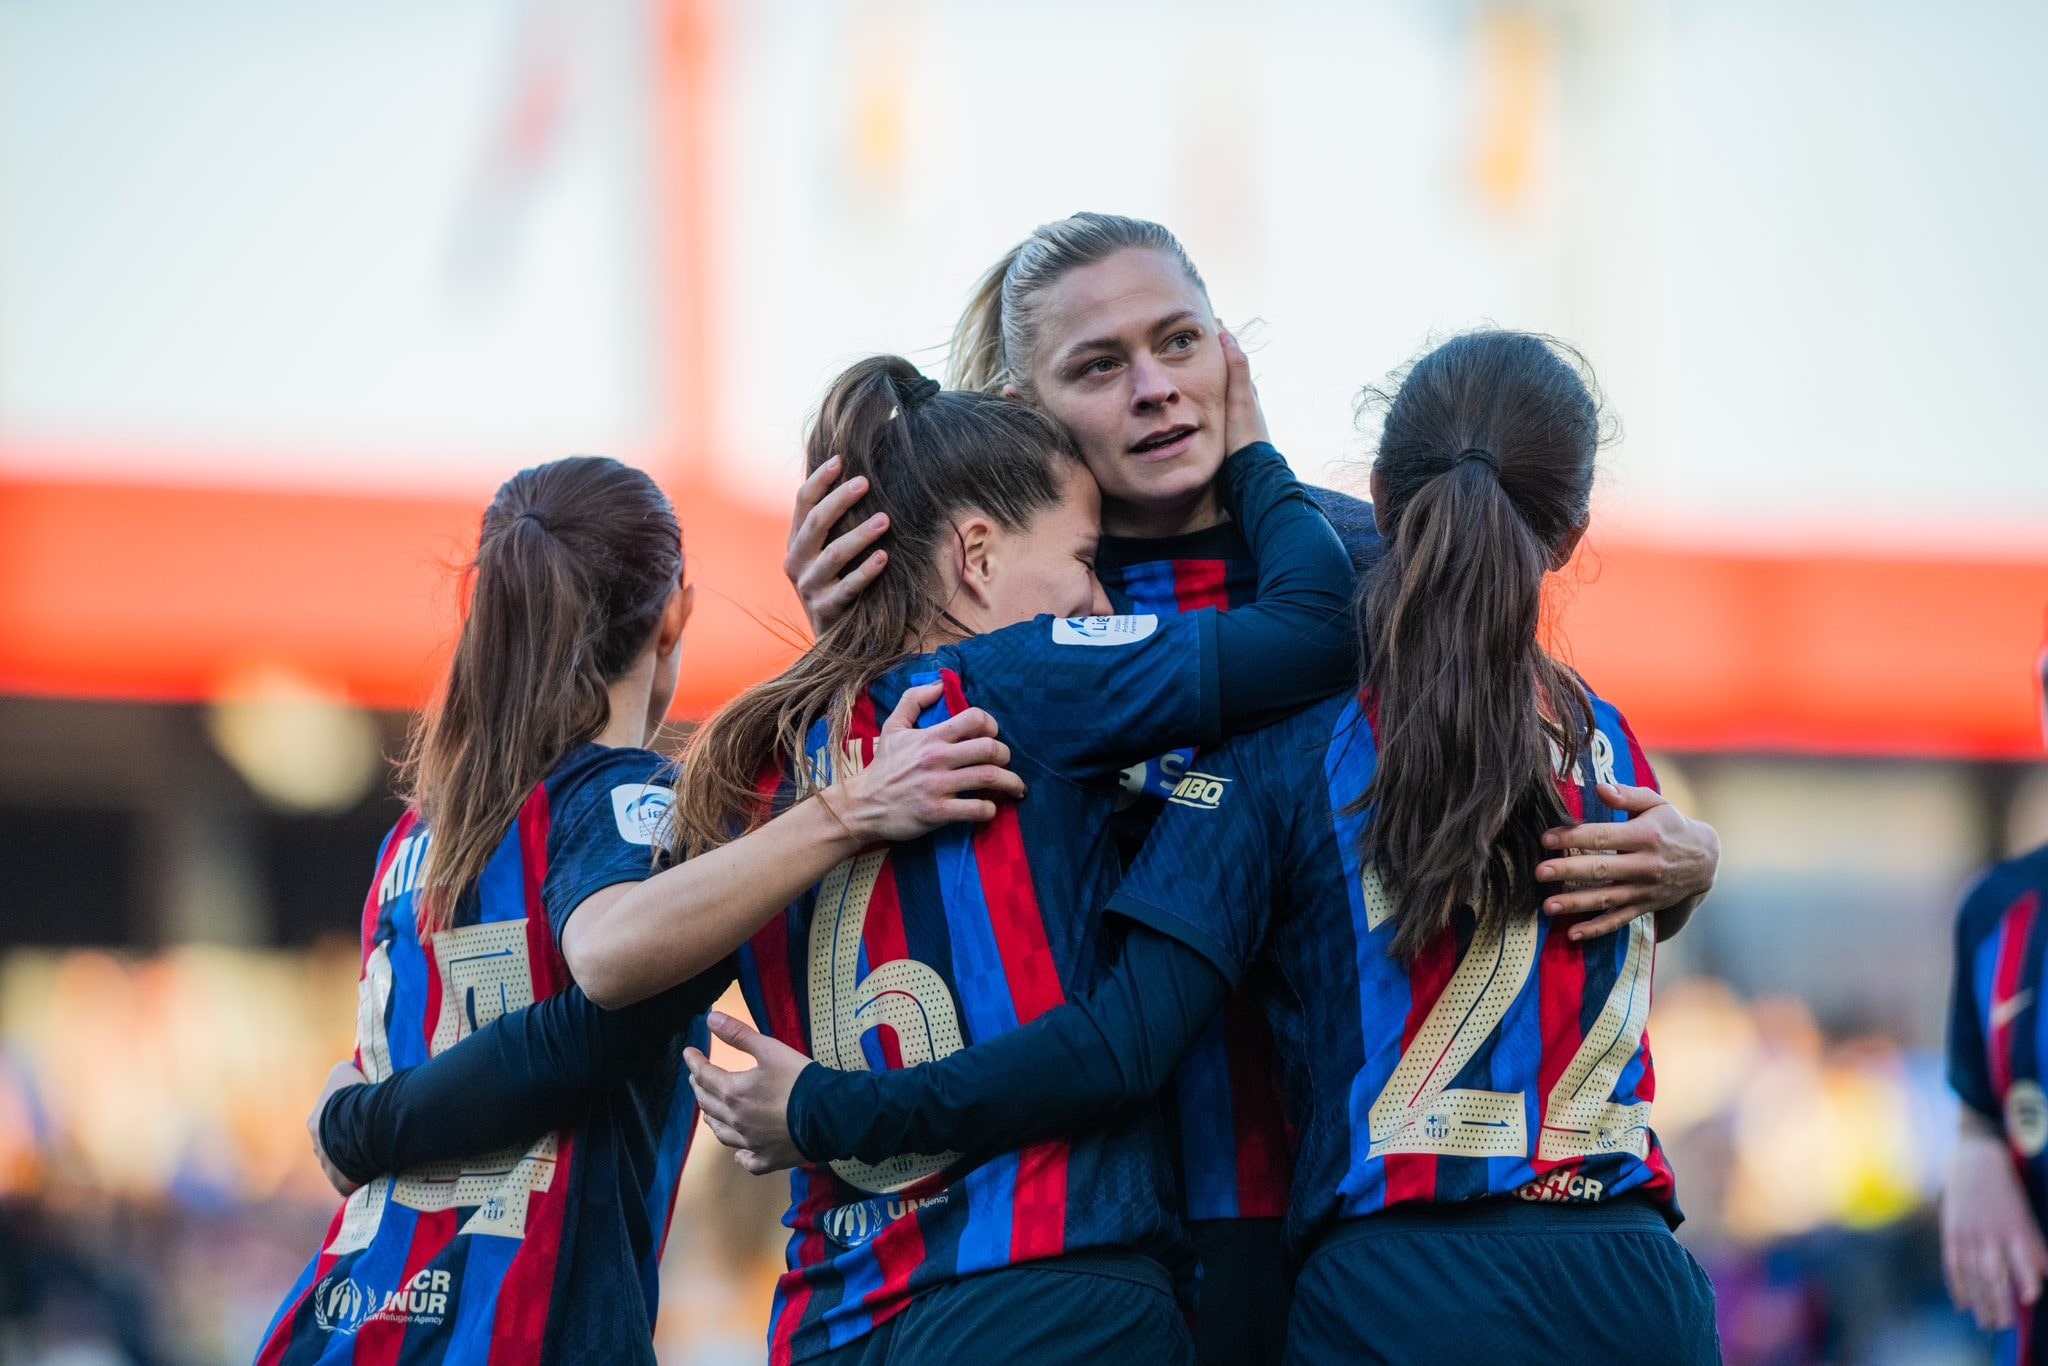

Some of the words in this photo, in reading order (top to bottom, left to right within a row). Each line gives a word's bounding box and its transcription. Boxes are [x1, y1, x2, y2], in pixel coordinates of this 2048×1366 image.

[807, 848, 965, 1194] 6
[1360, 847, 1654, 1161] 22
[380, 1312, 413, 1324] Refugee
[413, 1314, 444, 1325] Agency
